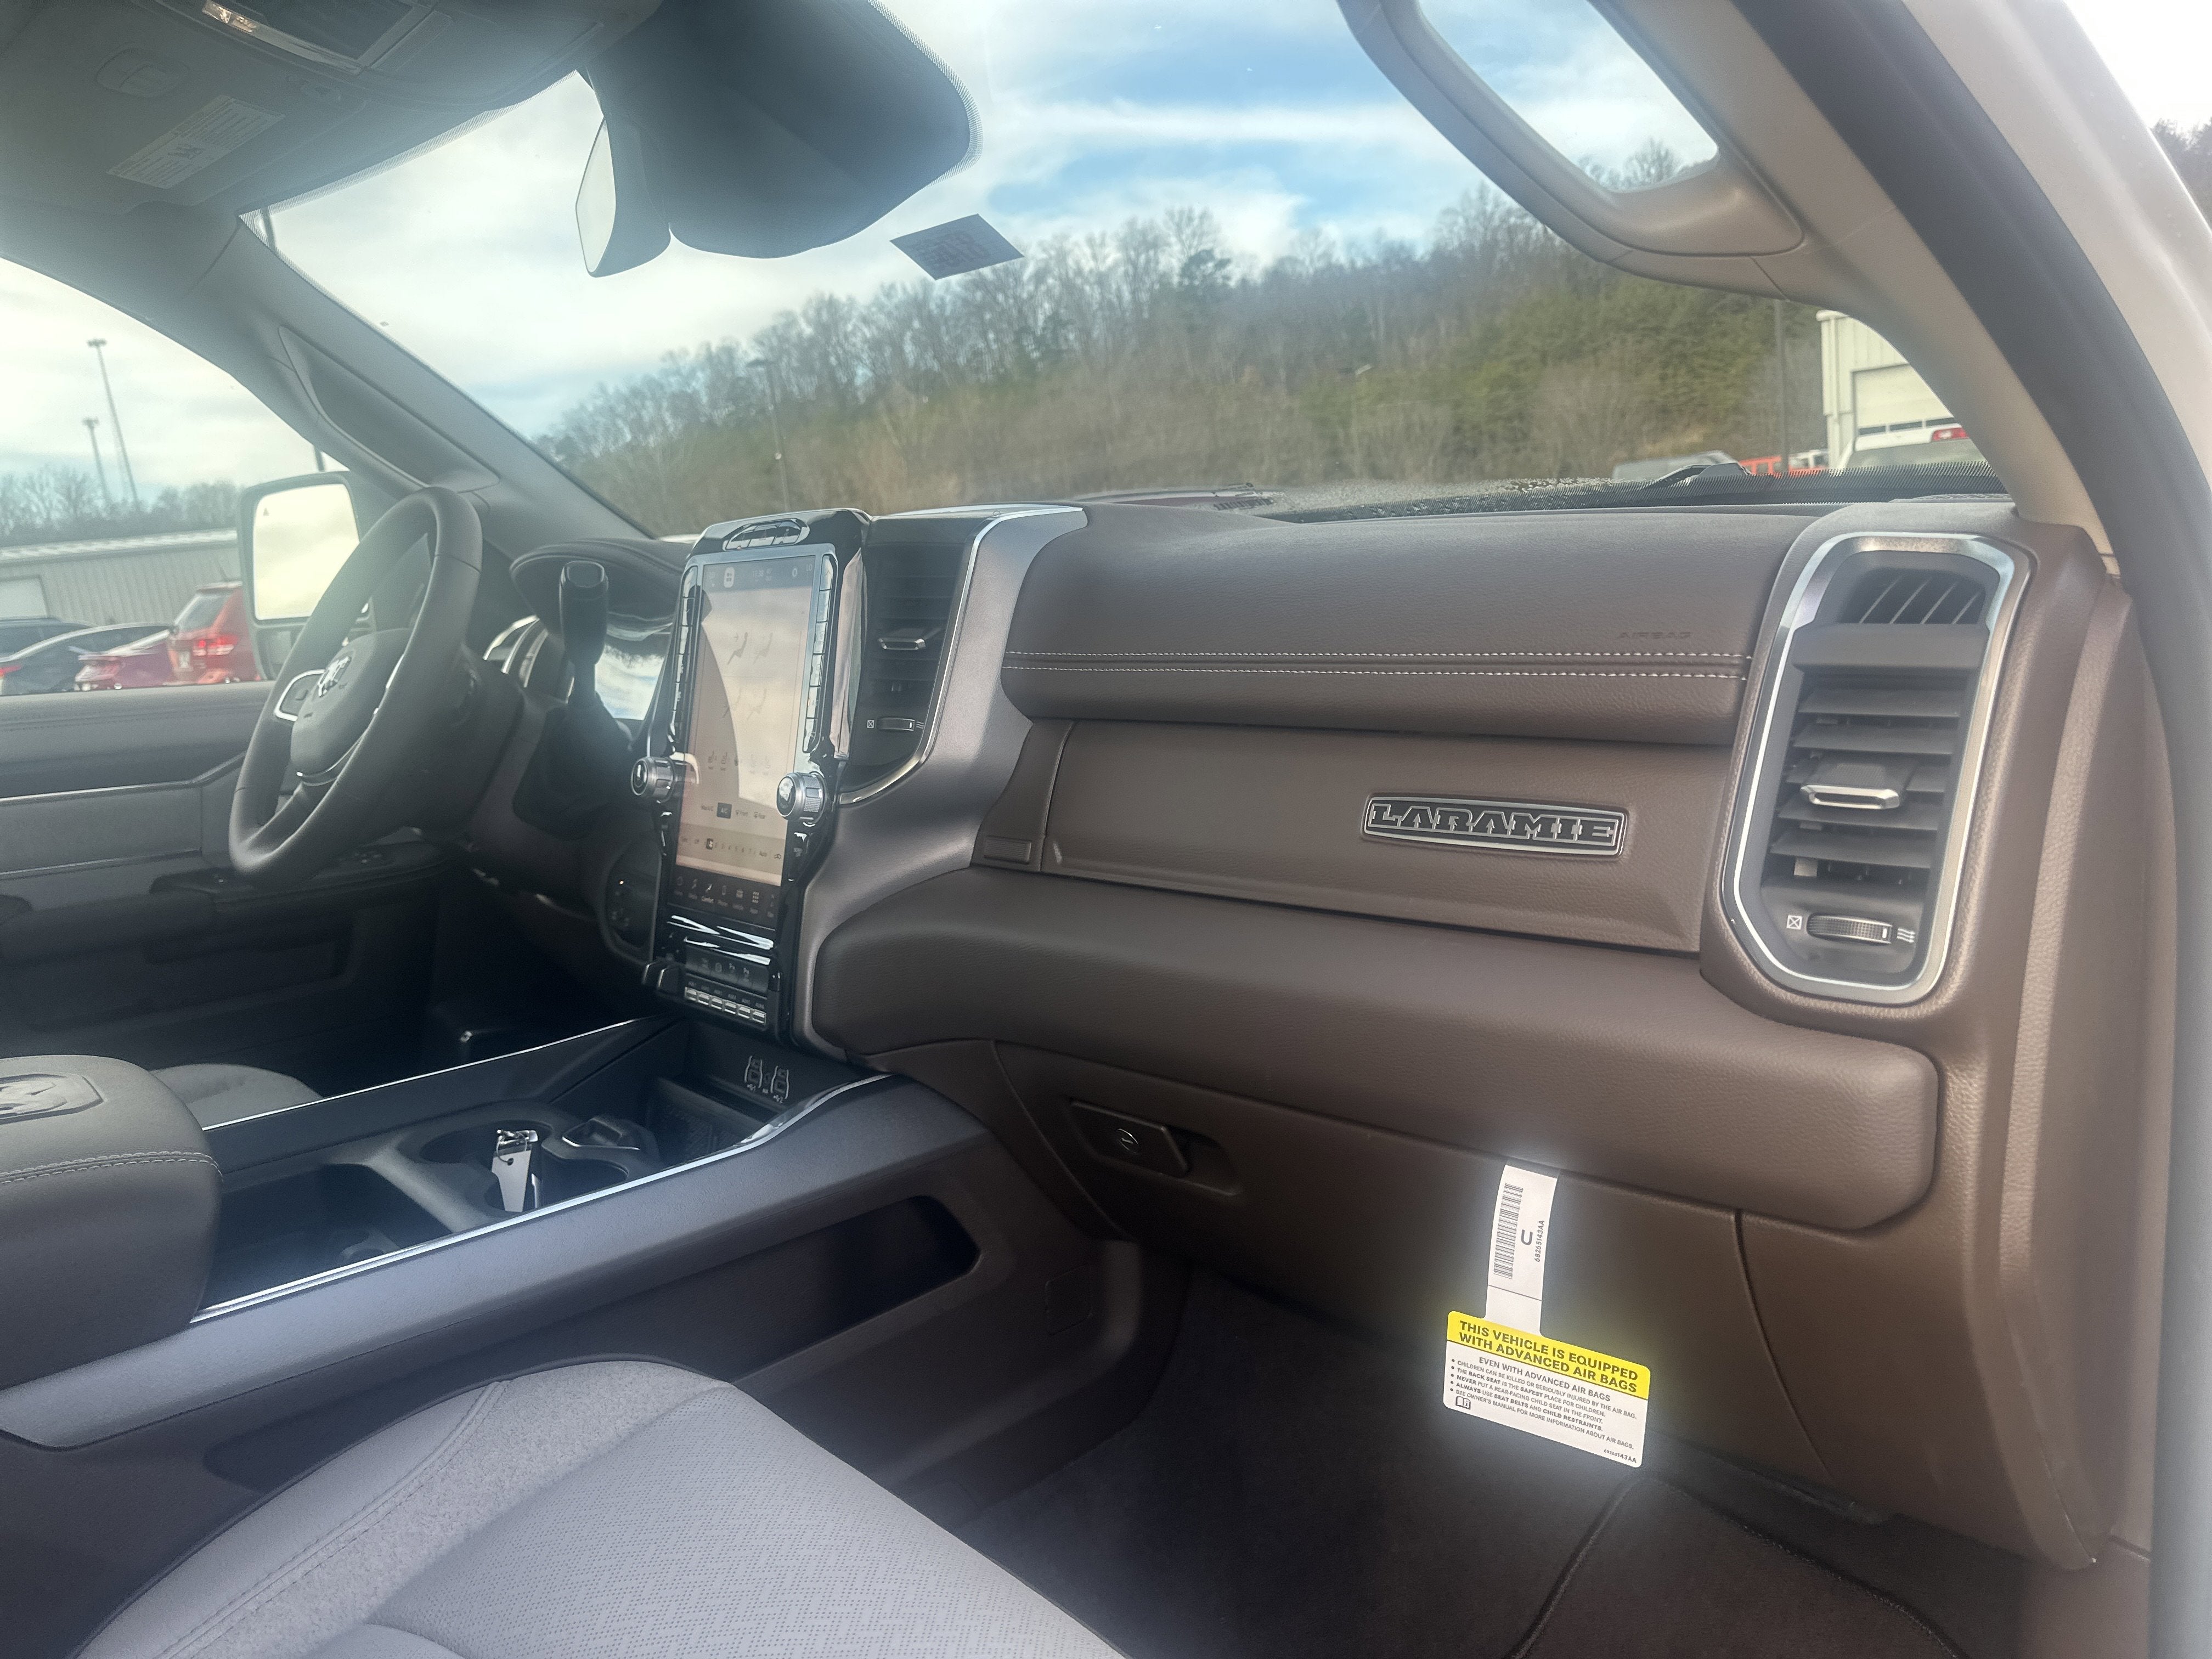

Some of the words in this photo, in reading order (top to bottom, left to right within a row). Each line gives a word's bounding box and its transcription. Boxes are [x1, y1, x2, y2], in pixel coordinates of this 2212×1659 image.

[1368, 803, 1619, 846] LARAMIE
[1521, 1229, 1533, 1245] U
[1534, 1220, 1545, 1262] 68265143AA
[1459, 1331, 1492, 1350] WITH
[1496, 1344, 1569, 1372] ADVANCED
[1573, 1366, 1596, 1381] AIR
[1600, 1374, 1637, 1392] BAGS
[1460, 1320, 1489, 1336] THIS
[1492, 1330, 1548, 1355] VEHICLE
[1552, 1347, 1565, 1359] IS
[1568, 1352, 1638, 1380] EQUIPPED
[1455, 1382, 1481, 1393] ALWAYS
[1494, 1393, 1509, 1402] SEAT
[1510, 1398, 1528, 1408] BELTS
[1543, 1408, 1562, 1419] CHILD
[1456, 1374, 1476, 1385] NEVER
[1494, 1386, 1530, 1401] REAR-FACING
[1531, 1397, 1548, 1407] CHILD
[1549, 1403, 1562, 1411] SEAT
[1571, 1409, 1582, 1418] THE
[1457, 1360, 1484, 1372] CHILDREN
[1506, 1374, 1525, 1385] KILLED
[1536, 1384, 1566, 1397] SERIOUSLY
[1567, 1392, 1590, 1404] INJURED
[1600, 1403, 1611, 1411] THE
[1468, 1370, 1485, 1380] BACK
[1486, 1376, 1501, 1385] SEAT
[1520, 1386, 1543, 1397] SAFEST
[1544, 1393, 1561, 1403] PLACE
[1562, 1399, 1574, 1407] FOR
[1479, 1356, 1499, 1368] EVEN
[1502, 1363, 1522, 1375] WITH
[1525, 1370, 1570, 1389] ADVANCED
[1571, 1385, 1585, 1395] AIR
[1588, 1389, 1610, 1402] BAGS
[1492, 1400, 1516, 1412] MANUAL
[1529, 1412, 1545, 1421] MORE
[1546, 1417, 1585, 1433] INFORMATION
[1585, 1430, 1605, 1440] ABOUT
